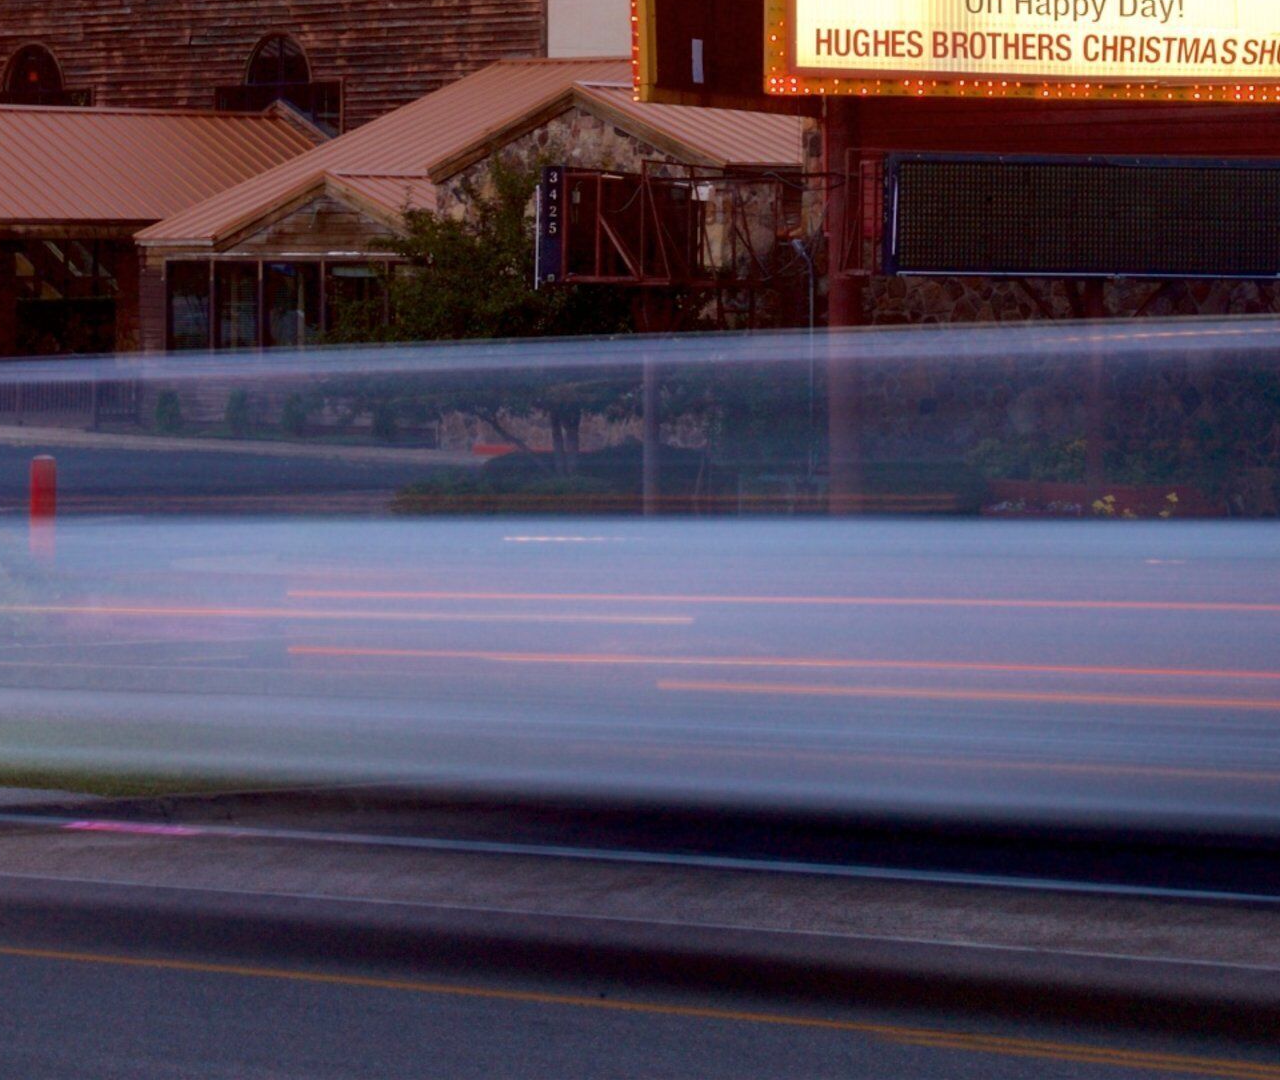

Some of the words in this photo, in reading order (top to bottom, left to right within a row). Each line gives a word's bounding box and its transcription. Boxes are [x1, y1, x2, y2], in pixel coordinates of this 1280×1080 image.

[815, 28, 923, 58] HUGHES
[933, 31, 1072, 62] BROTHERS
[1083, 34, 1238, 65] CHRISTMAS
[549, 172, 558, 234] 3425
